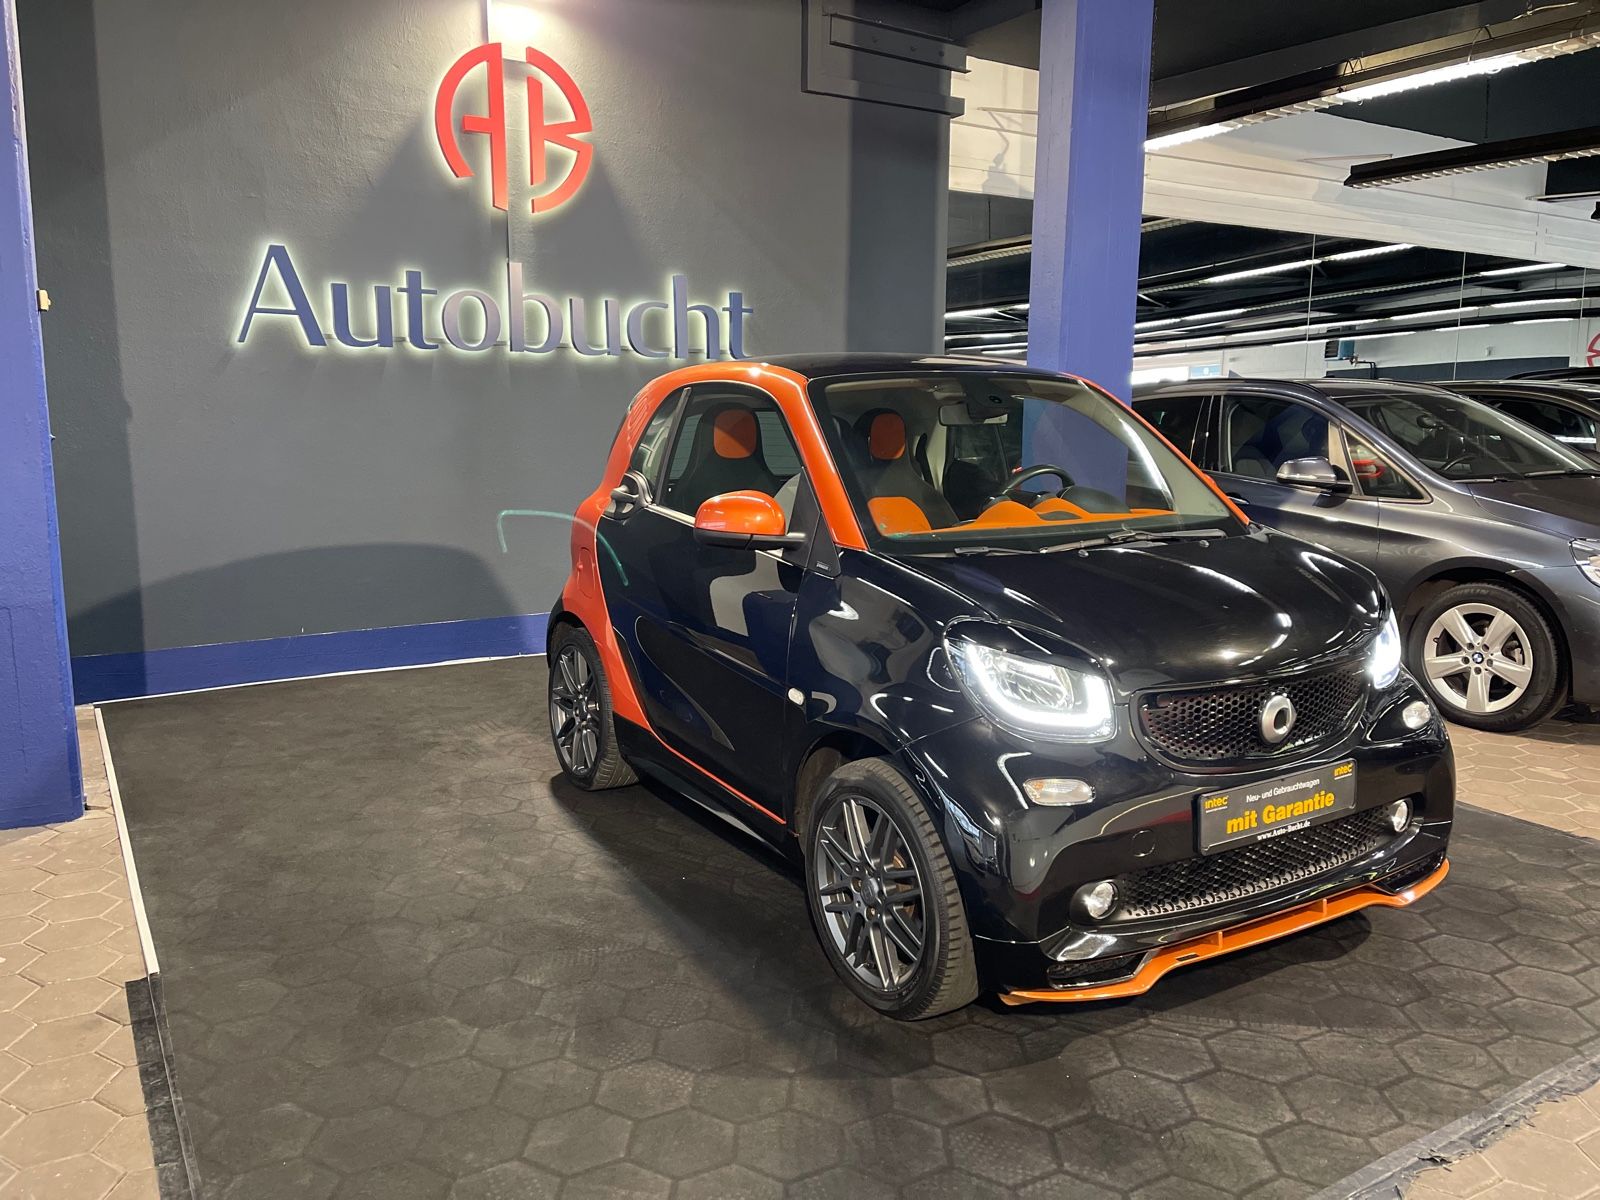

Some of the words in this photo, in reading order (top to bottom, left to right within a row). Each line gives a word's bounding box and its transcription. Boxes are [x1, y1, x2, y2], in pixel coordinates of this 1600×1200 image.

[237, 244, 754, 359] Autobucht
[1226, 809, 1258, 834] mit
[1262, 790, 1335, 825] Garantie
[1246, 793, 1261, 803] Neu-
[1261, 788, 1273, 799] und
[1273, 778, 1320, 796] Gebrauchtwagen
